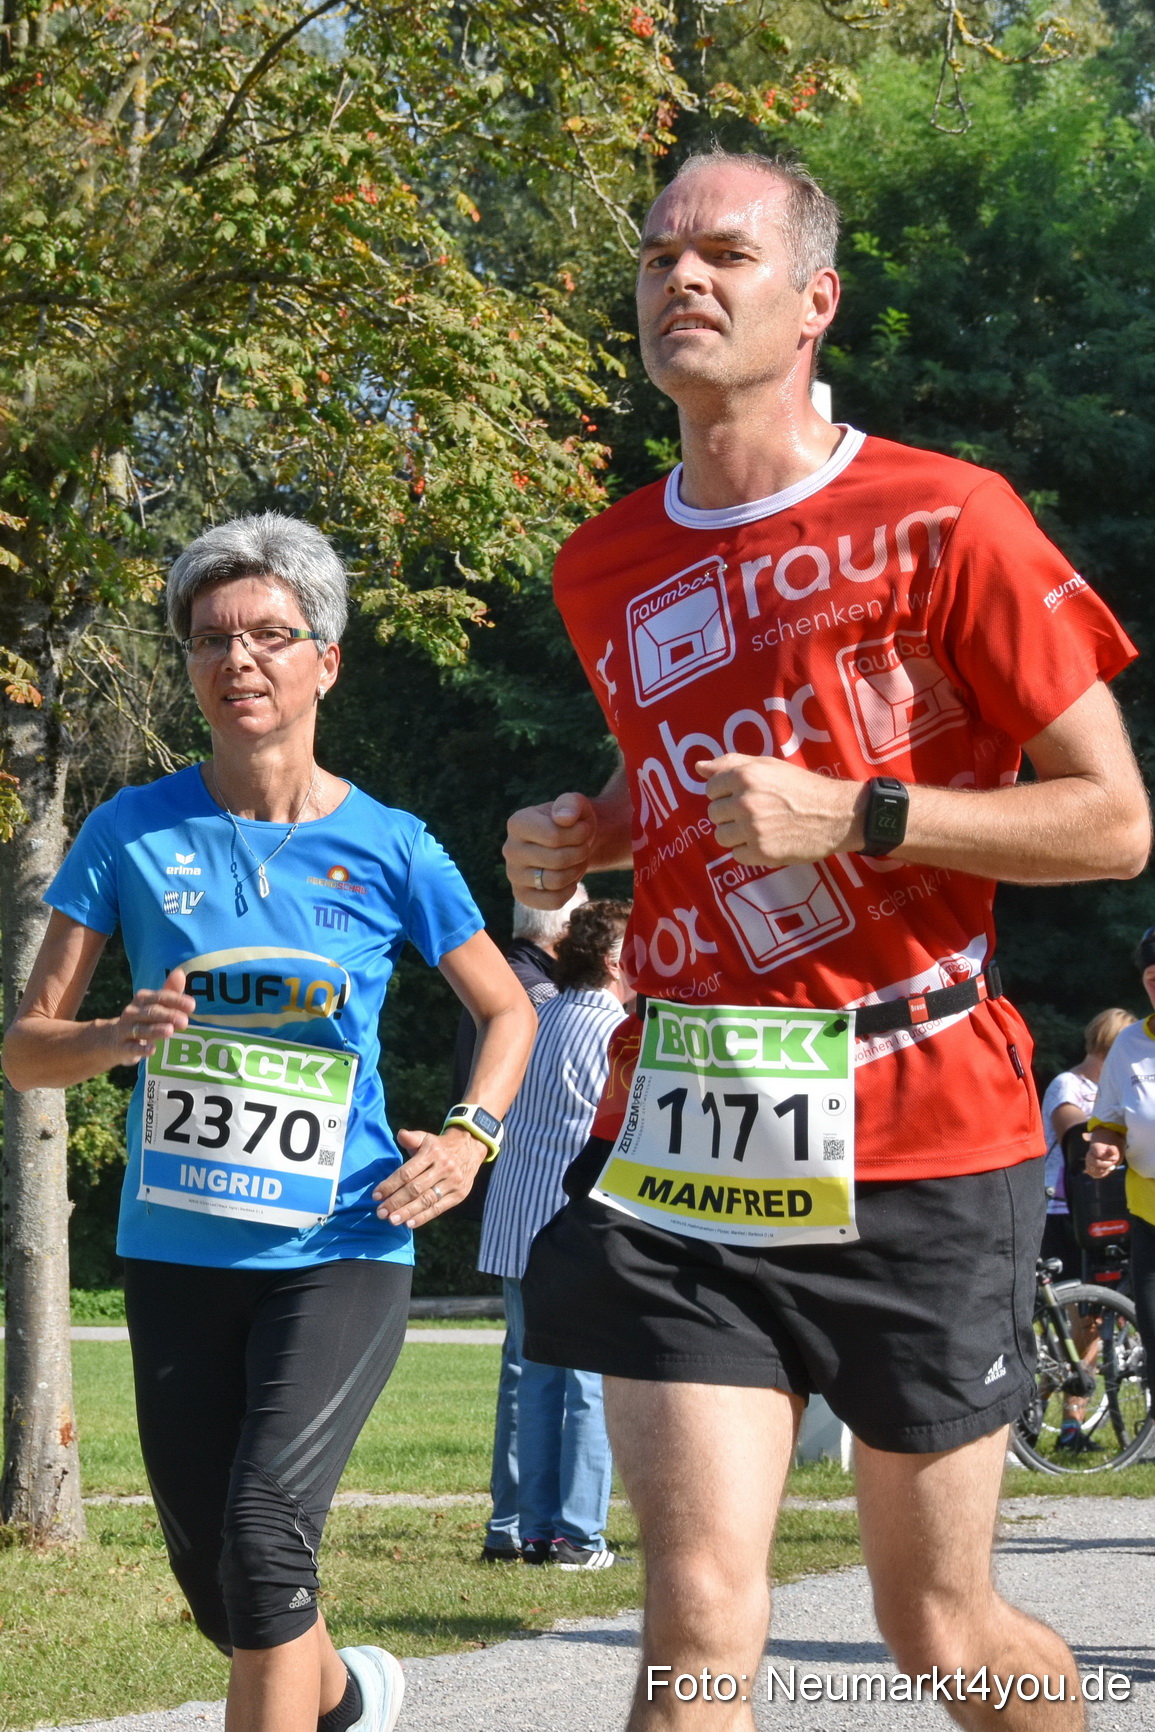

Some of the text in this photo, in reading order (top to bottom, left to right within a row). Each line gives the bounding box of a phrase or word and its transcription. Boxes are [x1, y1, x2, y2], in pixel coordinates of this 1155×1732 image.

[633, 573, 713, 625] raumbox
[752, 599, 883, 652] schenken
[166, 865, 202, 875] erima
[163, 890, 205, 915] BLV
[313, 905, 350, 932] TUM
[165, 968, 347, 1020] AUF10!
[659, 1013, 826, 1068] BOCK
[163, 1034, 332, 1094] BOCK
[163, 1090, 321, 1162] 2370
[327, 1119, 337, 1129] D
[657, 1088, 809, 1162] 1171
[828, 1099, 840, 1111] D
[180, 1164, 283, 1200] INGRID
[637, 1175, 813, 1218] MANFRED
[289, 1596, 312, 1609] adidas
